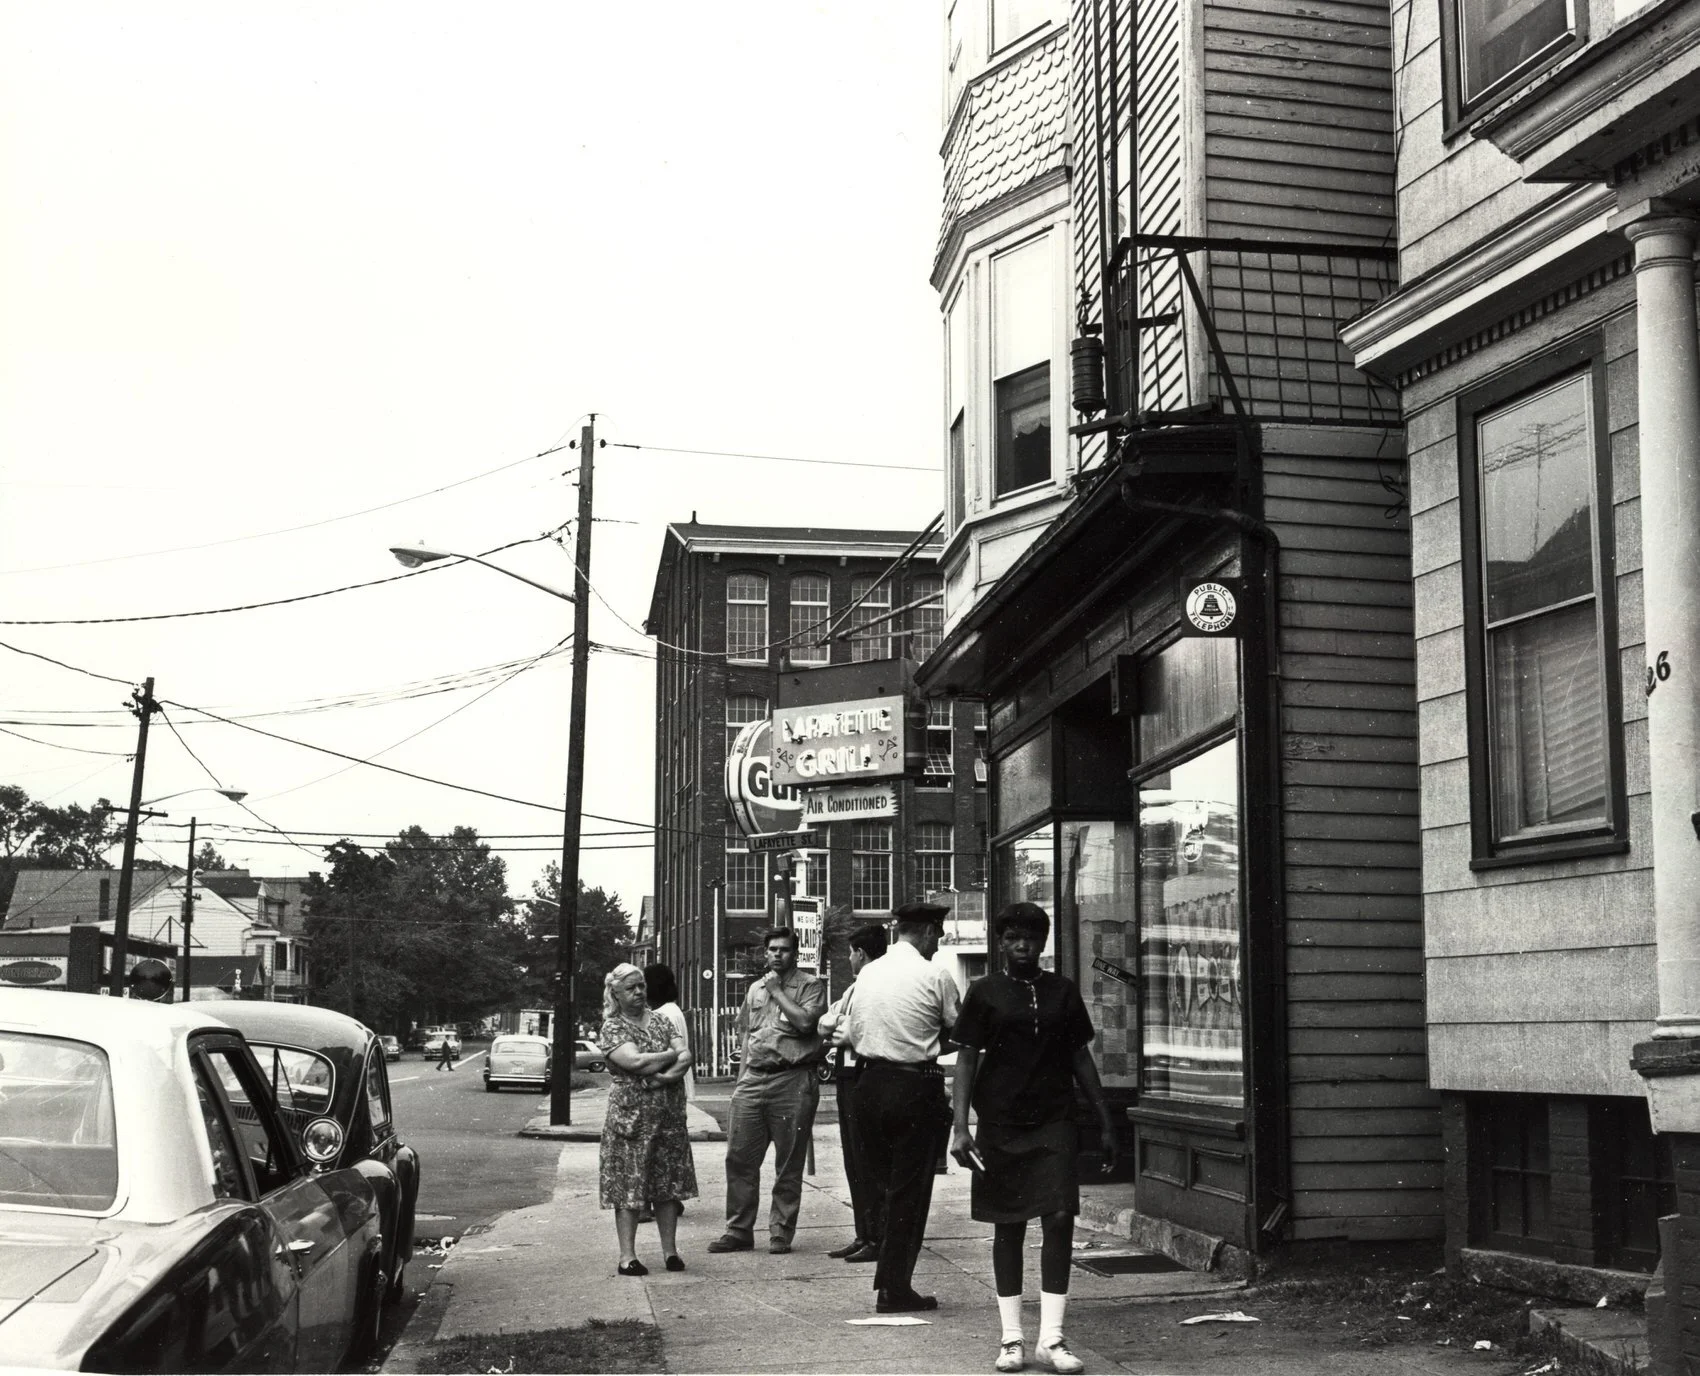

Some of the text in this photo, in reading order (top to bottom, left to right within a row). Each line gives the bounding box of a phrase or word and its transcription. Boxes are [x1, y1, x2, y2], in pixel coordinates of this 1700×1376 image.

[1194, 584, 1228, 596] PUBLIC
[1190, 611, 1234, 630] TELEPHONE
[782, 707, 892, 743] LAFAYETTE
[796, 743, 879, 778] GRILL
[754, 835, 796, 849] LAFAYETTE
[1094, 959, 1120, 977] ONE WAY
